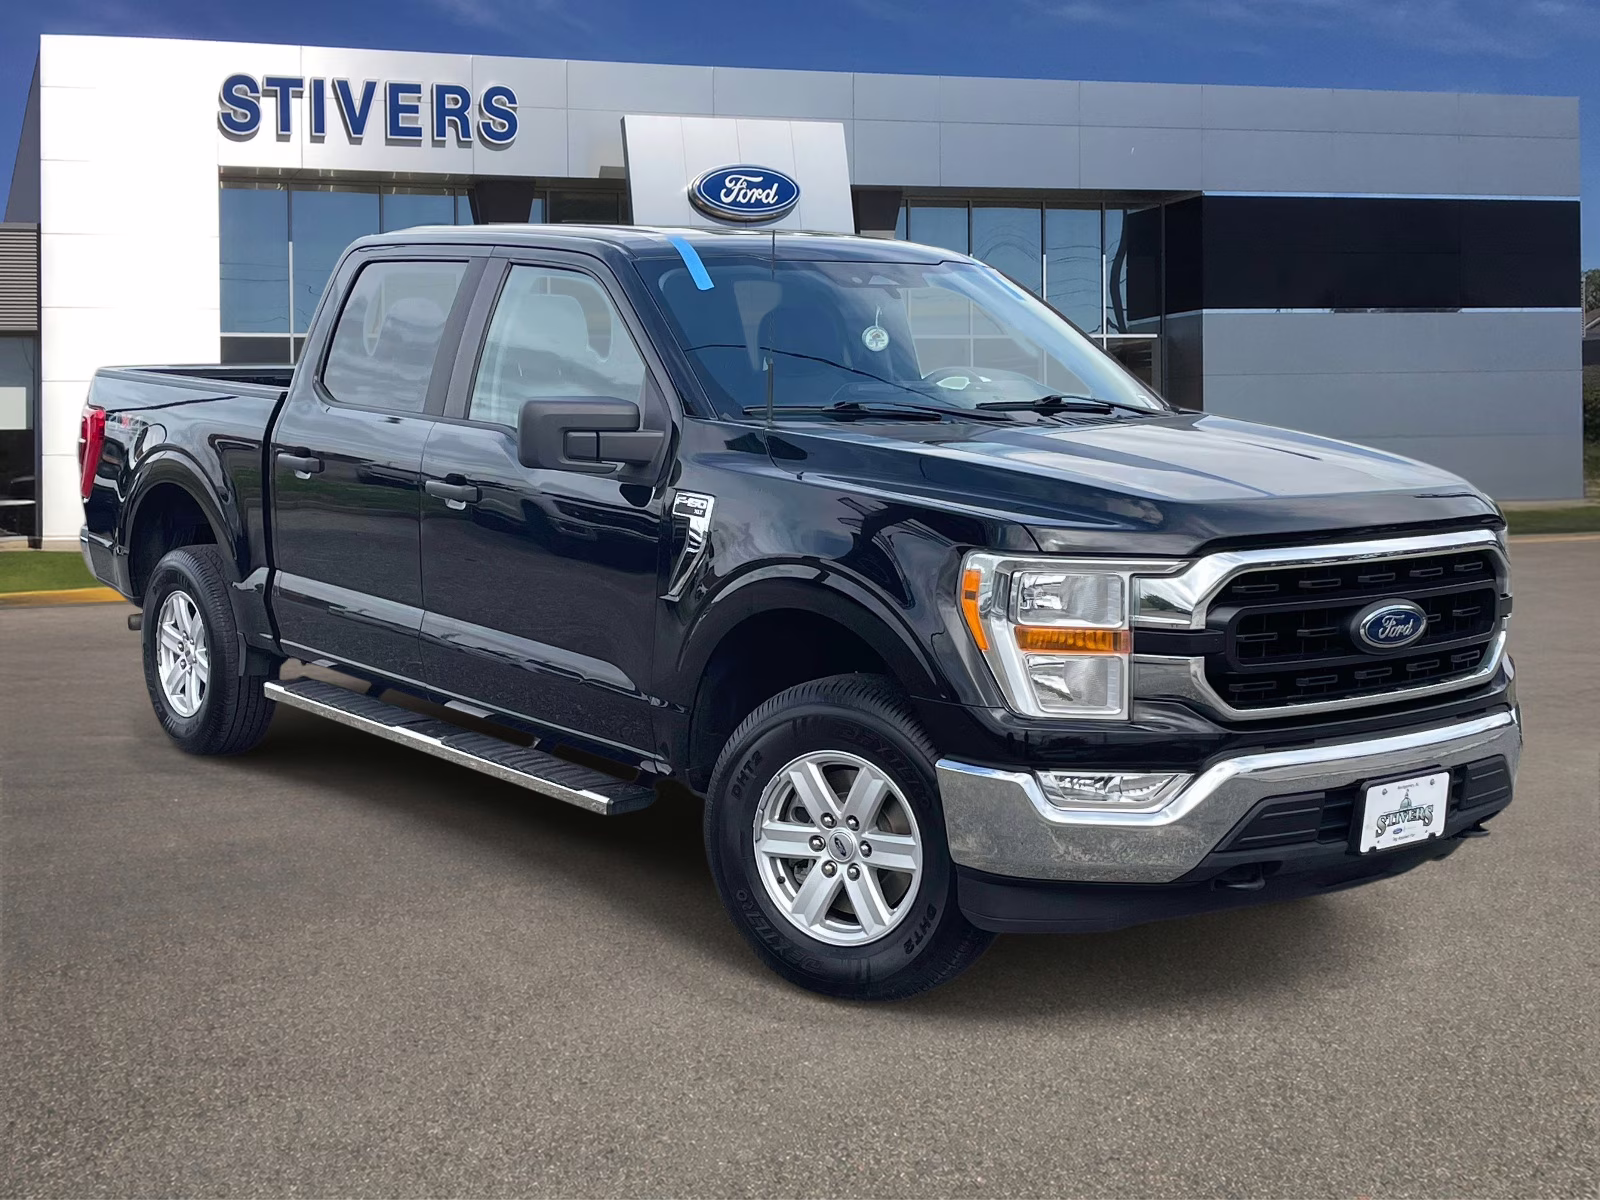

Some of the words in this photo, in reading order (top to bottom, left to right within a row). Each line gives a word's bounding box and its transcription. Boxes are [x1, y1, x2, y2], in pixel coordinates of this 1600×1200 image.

[218, 72, 519, 146] STIVERS
[720, 174, 778, 204] Ford
[1378, 614, 1414, 639] Ford
[731, 750, 763, 800] DHT2
[1375, 804, 1434, 838] STIVERS
[903, 902, 938, 955] DHT2
